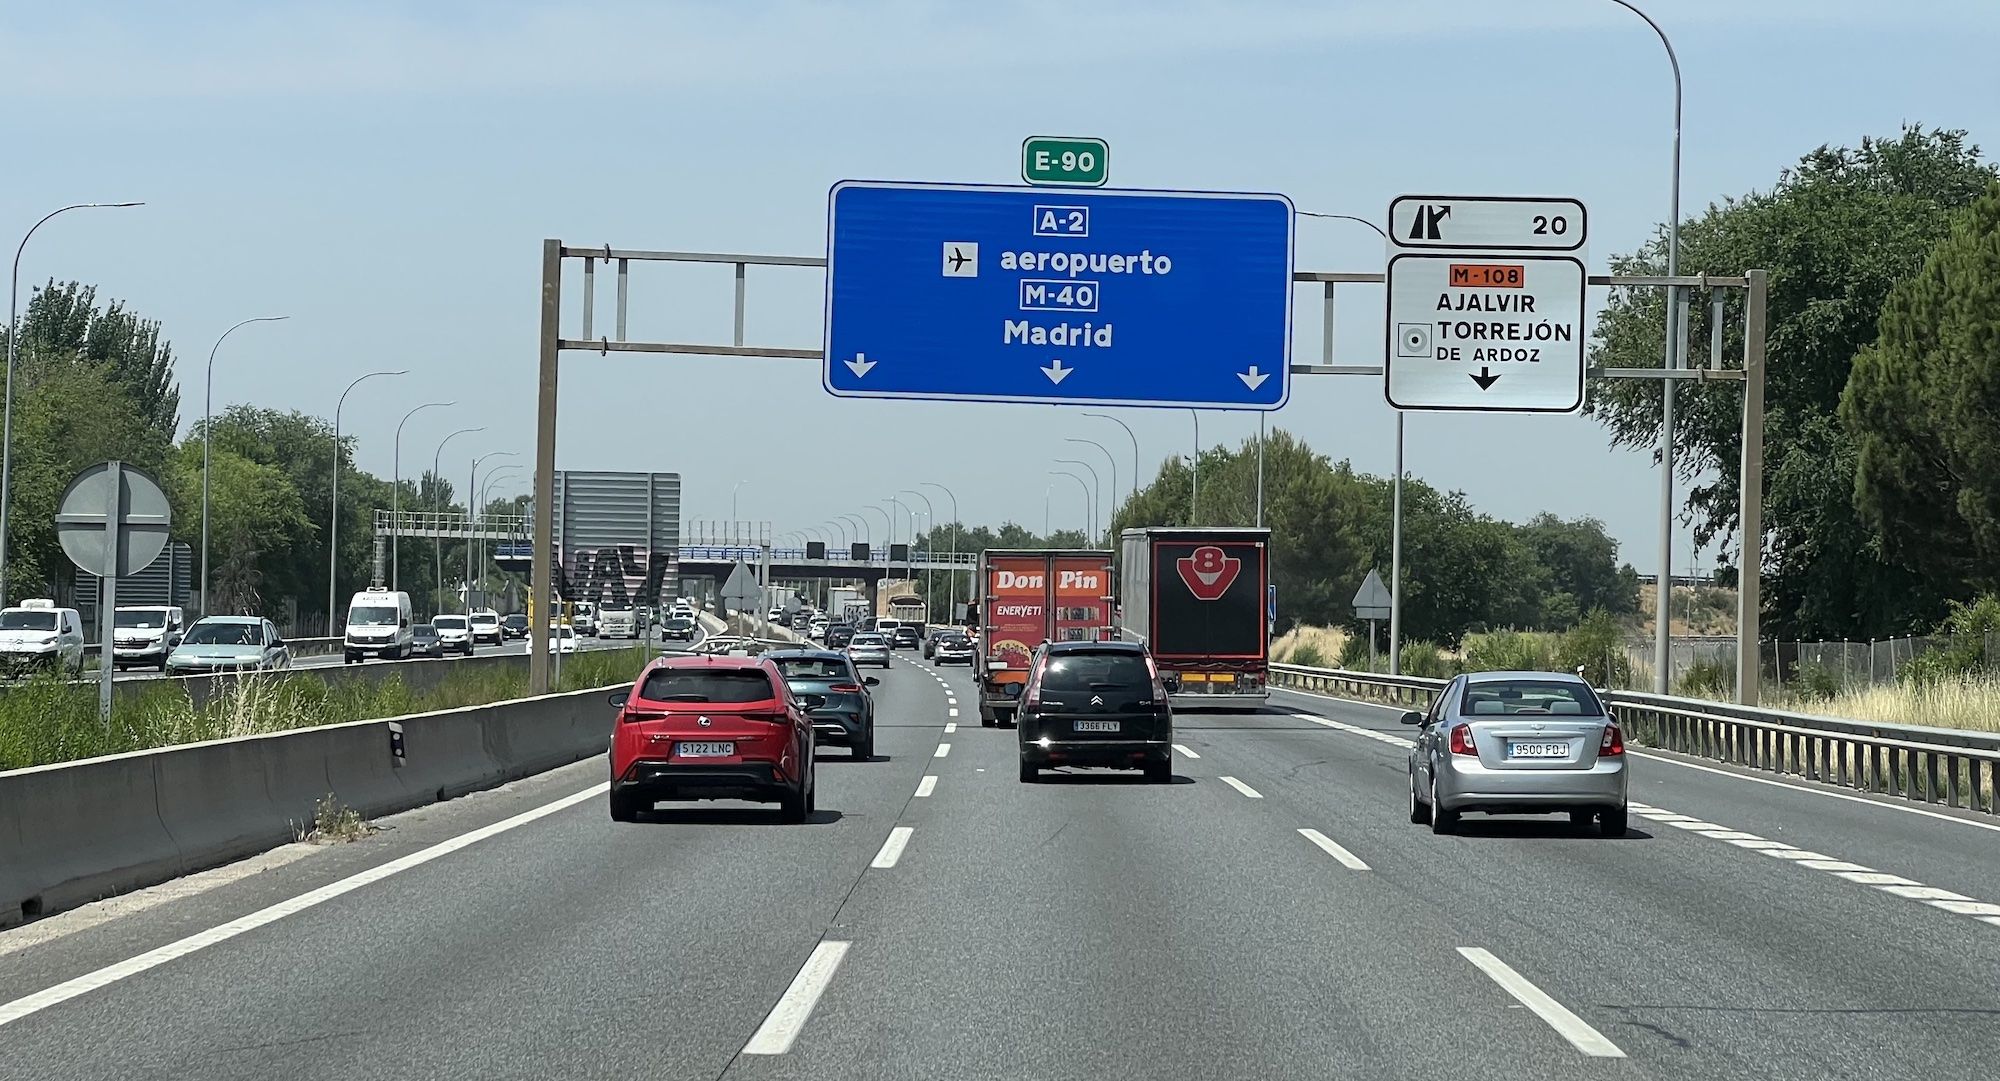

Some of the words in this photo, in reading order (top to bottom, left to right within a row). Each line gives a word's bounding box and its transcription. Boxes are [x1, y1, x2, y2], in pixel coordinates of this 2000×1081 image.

[1035, 151, 1095, 172] E-90
[1039, 211, 1084, 232] A-2
[1532, 215, 1567, 235] 20
[1001, 249, 1172, 278] aeropuerto
[1454, 269, 1519, 284] M-108
[1024, 285, 1093, 307] M-40
[1436, 293, 1535, 313] AJALVIR
[1004, 320, 1113, 348] Madrid
[1437, 319, 1571, 342] TORREJÓN
[1436, 347, 1461, 361] DE
[1472, 348, 1540, 363] ARDOZ
[996, 571, 1043, 589] Don
[1059, 571, 1098, 589] Pin
[997, 605, 1042, 618] ENERYETI
[682, 743, 708, 753] 5122
[711, 744, 732, 753] LNC
[1516, 744, 1542, 755] 9500
[1545, 744, 1566, 755] FDJ
